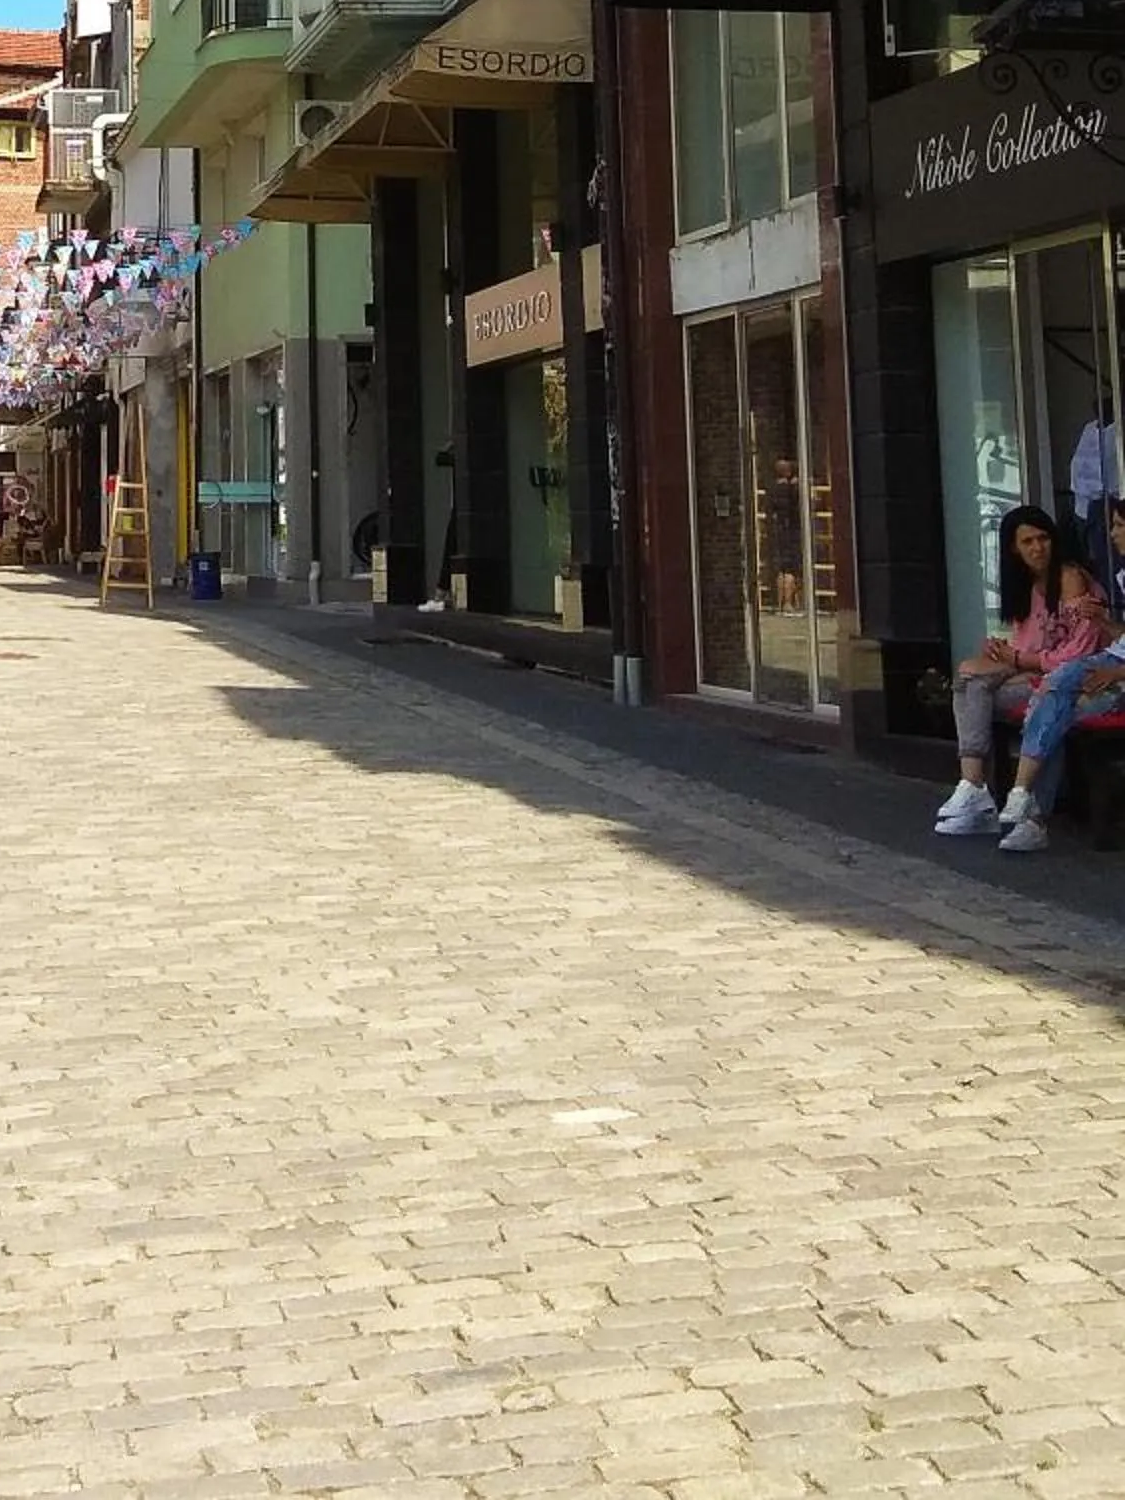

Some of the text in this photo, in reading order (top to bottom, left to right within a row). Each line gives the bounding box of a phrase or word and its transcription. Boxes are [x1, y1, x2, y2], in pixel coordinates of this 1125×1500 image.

[437, 46, 586, 77] ESORDIO
[986, 103, 1107, 173] Collection
[474, 291, 553, 341] ESORDIO
